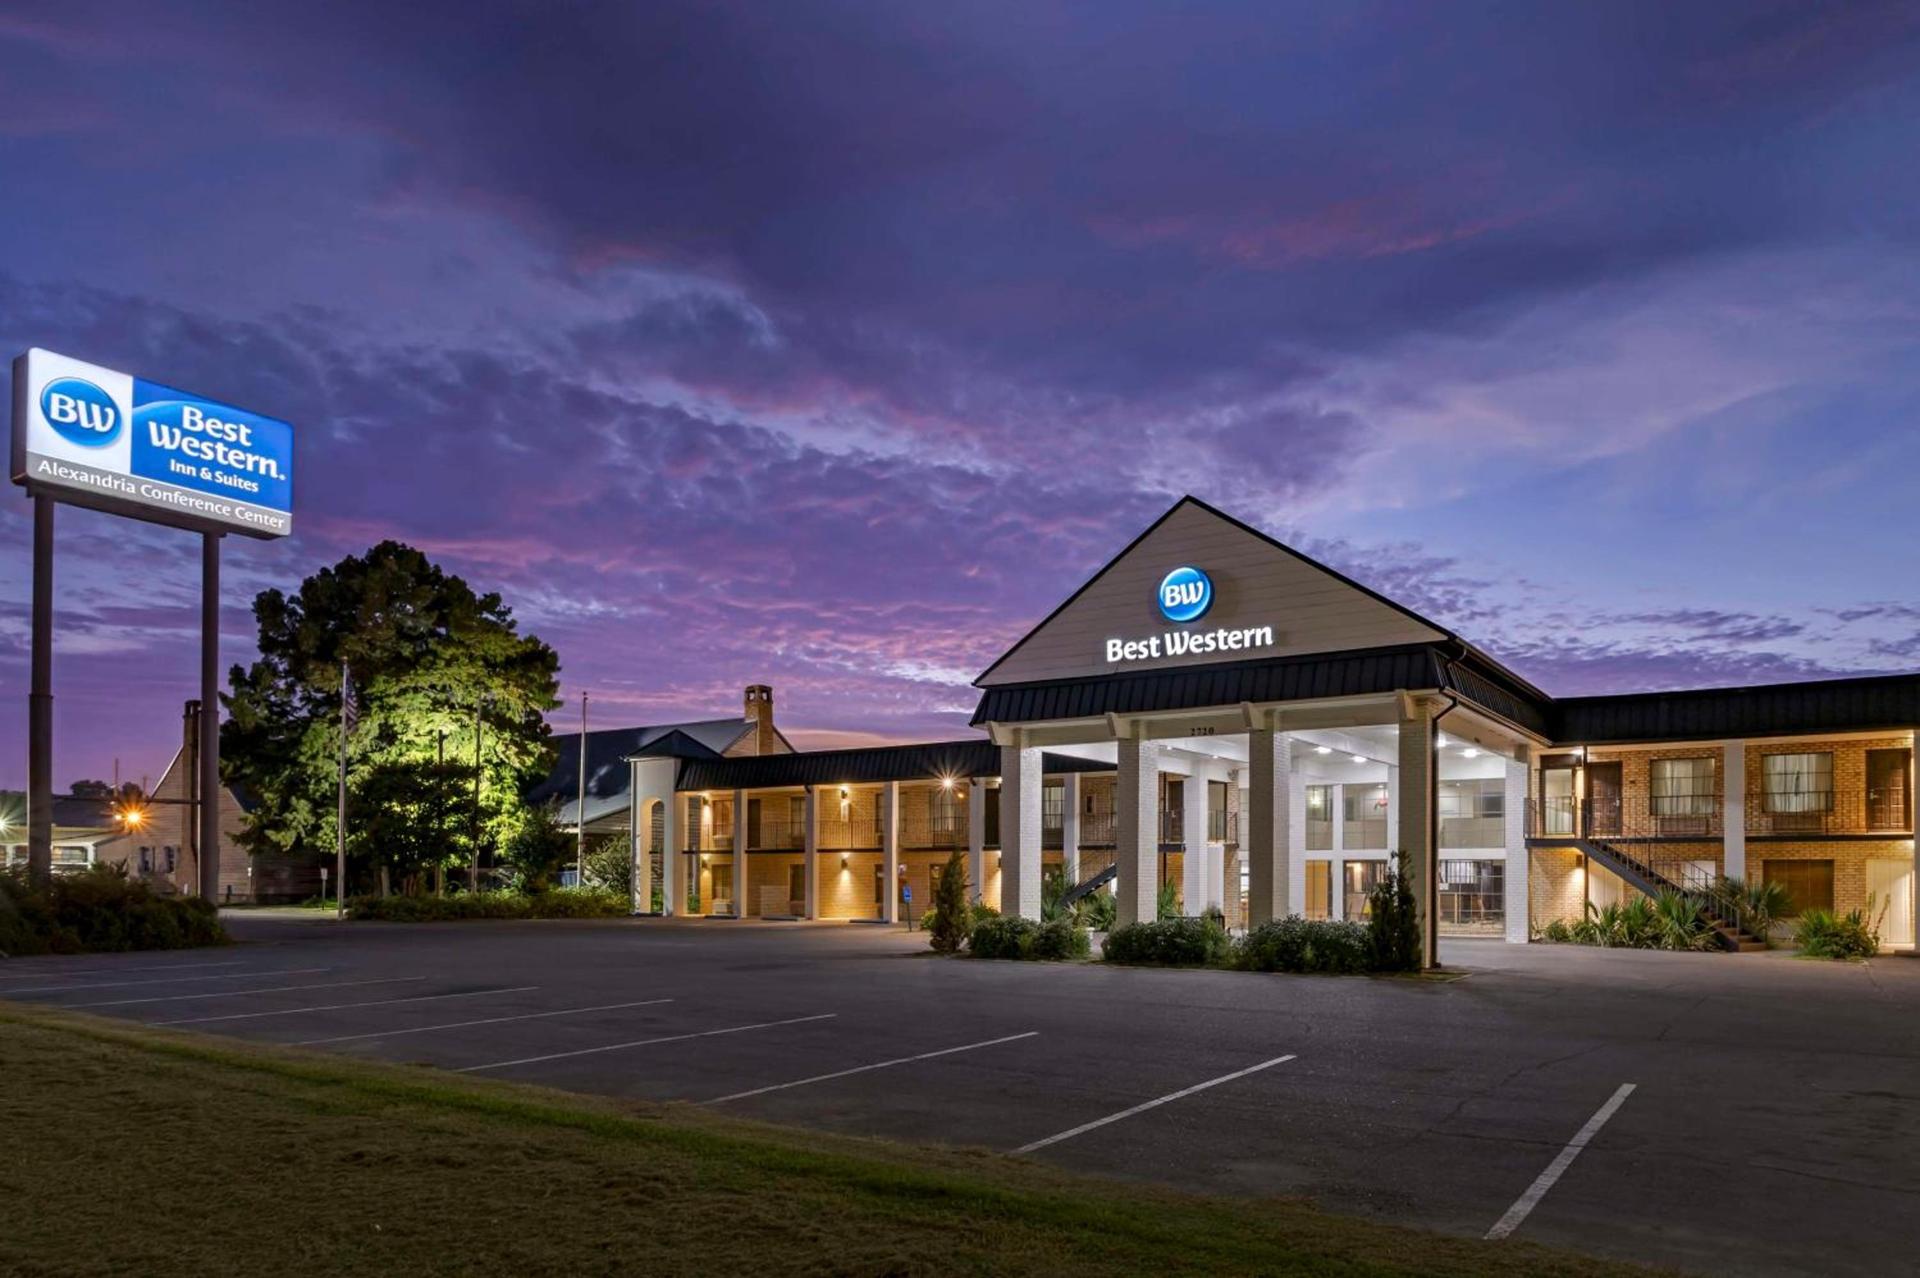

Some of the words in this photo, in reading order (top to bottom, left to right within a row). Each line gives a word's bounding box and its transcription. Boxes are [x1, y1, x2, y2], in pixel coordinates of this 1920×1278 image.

[50, 393, 115, 432] BW
[182, 405, 252, 446] Best
[38, 460, 136, 494] Alexandria
[140, 485, 231, 517] Conference
[235, 506, 285, 529] Center
[170, 459, 197, 474] Inn
[201, 468, 213, 480] &
[215, 471, 259, 493] Suites
[1164, 581, 1204, 607] BW
[1106, 637, 1161, 662] Best
[1165, 626, 1273, 656] Western
